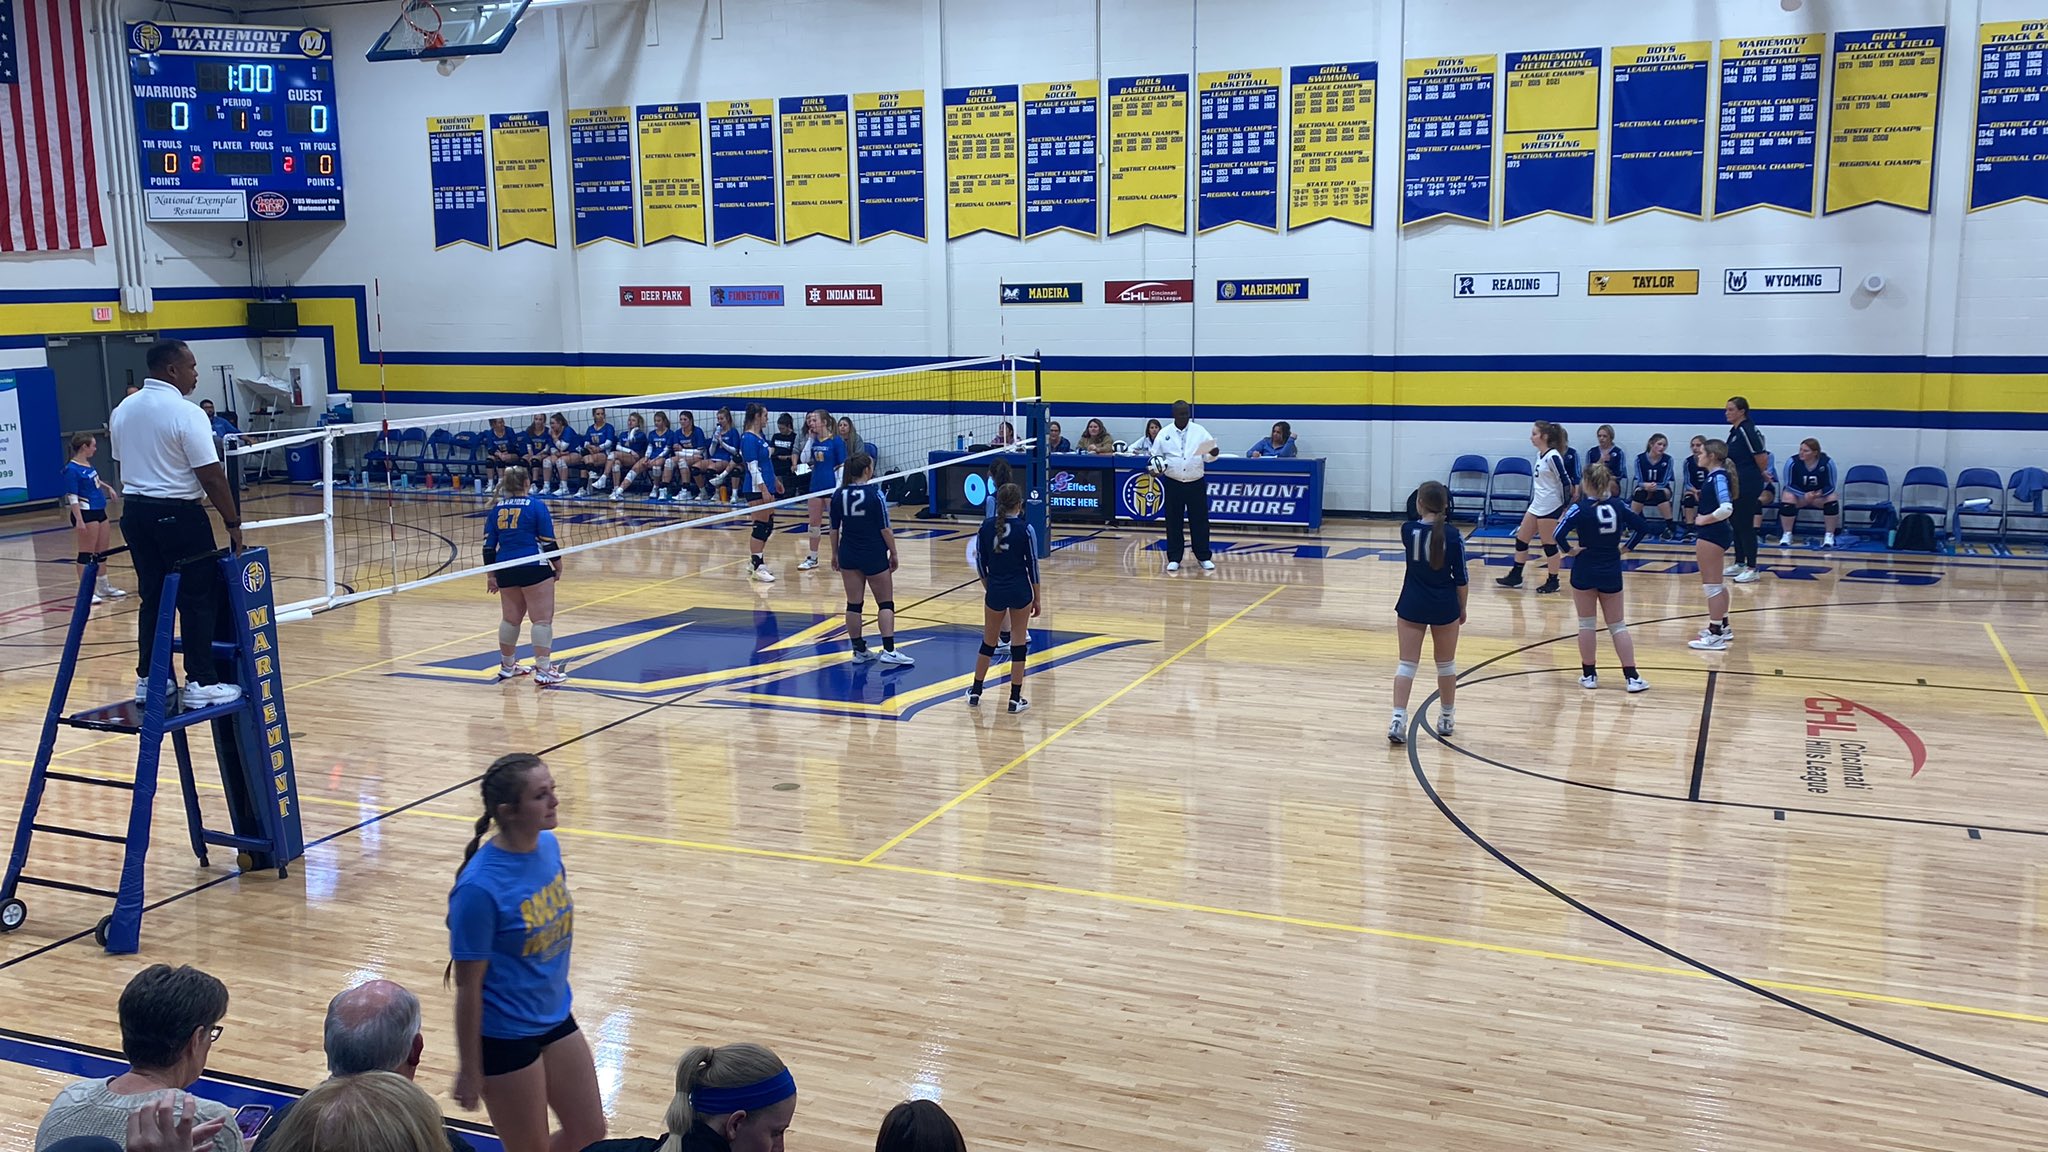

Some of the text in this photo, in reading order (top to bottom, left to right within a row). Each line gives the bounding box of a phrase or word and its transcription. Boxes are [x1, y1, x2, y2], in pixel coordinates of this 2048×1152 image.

[171, 28, 289, 42] MARIEMONT
[1872, 31, 1907, 41] GIRLS
[1991, 32, 2045, 42] TRACK &
[177, 40, 281, 53] WARRIORS
[1737, 37, 1807, 49] MARIEMONT
[1844, 39, 1934, 51] TRACK & FIELD
[1998, 43, 2034, 52] LEAGUE
[1647, 46, 1676, 54] BOYS
[1742, 47, 1800, 57] BASEBALL
[1522, 50, 1586, 62] MARIEMONT
[1636, 54, 1686, 64] BOWLING
[1438, 59, 1464, 67] BOYS
[1514, 59, 1592, 70] CHEERLEADING
[1320, 66, 1347, 74] GIRLS
[1424, 66, 1477, 75] SWIMMING
[228, 65, 272, 92] 1:00
[1308, 73, 1359, 83] SWIMMING
[1120, 85, 1177, 94] BASKETBALL
[1211, 80, 1269, 88] BASKETBALL
[134, 85, 197, 98] WARRIORS
[288, 89, 322, 101] GUEST
[223, 98, 252, 107] PERIOD
[172, 102, 189, 130] 0
[241, 112, 244, 129] 1
[311, 106, 326, 132] 0
[1619, 120, 1661, 128] SECTIONAL
[1537, 133, 1564, 141] BOYS
[143, 140, 182, 149] TM FOULS
[213, 141, 273, 150] PLAYER FOULS
[1521, 141, 1580, 149] WRESTLING
[1513, 152, 1553, 160] SECTIONAL
[1659, 150, 1693, 158] CHAMPS
[165, 154, 176, 173] 0
[192, 156, 201, 171] 2
[284, 157, 292, 171] 2
[320, 155, 331, 173] 0
[1839, 160, 1882, 168] REGIONAL
[151, 177, 180, 185] POINTS
[231, 178, 258, 186] MATCH
[155, 195, 237, 207] National Exemplar
[173, 207, 220, 215] Restaurant
[1491, 277, 1541, 291] READING
[1632, 276, 1675, 288] TAYLOR
[1764, 274, 1823, 287] WYOMING
[641, 290, 682, 300] DEER PARK
[826, 289, 876, 300] INDIAN HILL
[1029, 287, 1070, 299] MADEIRA
[1241, 283, 1301, 296] MARIEMONT
[1121, 292, 1149, 300] CHL
[97, 308, 110, 320] EXIT
[1067, 483, 1096, 491] Effects
[1206, 483, 1309, 498] RIEMONT
[842, 489, 865, 516] 12
[1051, 497, 1076, 506] ERTISE
[1078, 498, 1099, 507] HERE
[1208, 499, 1296, 515] RRIORS
[497, 508, 521, 529] 27
[1597, 504, 1616, 533] 9
[1805, 697, 1857, 736] CHL
[1800, 740, 1832, 794] Hills League
